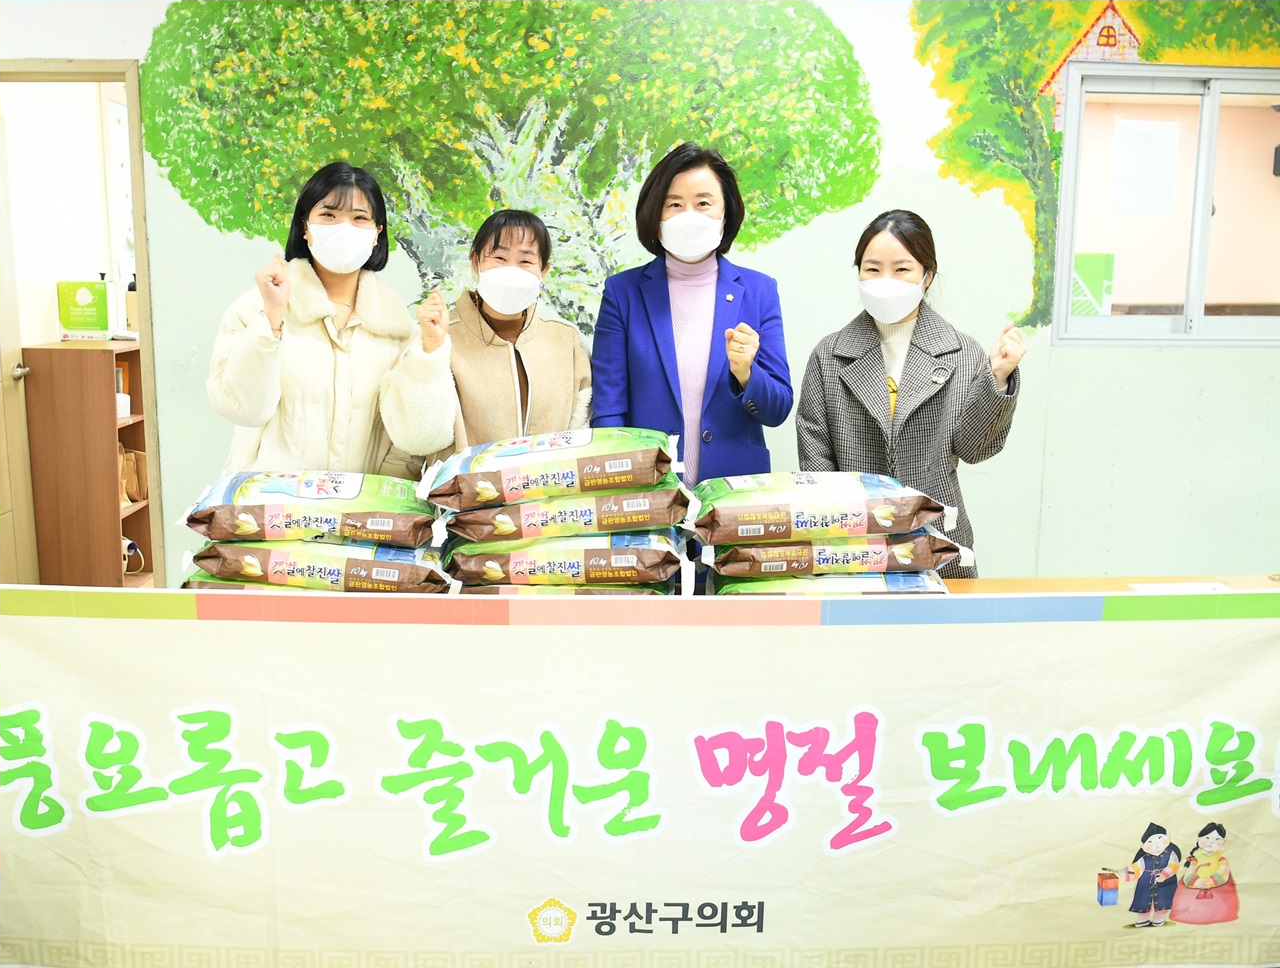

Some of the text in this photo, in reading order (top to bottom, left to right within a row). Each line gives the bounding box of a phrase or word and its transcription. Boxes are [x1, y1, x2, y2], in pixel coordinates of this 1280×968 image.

[381, 719, 661, 855] 즐거운
[694, 712, 892, 850] 명절
[586, 901, 765, 935] 광산구의회
